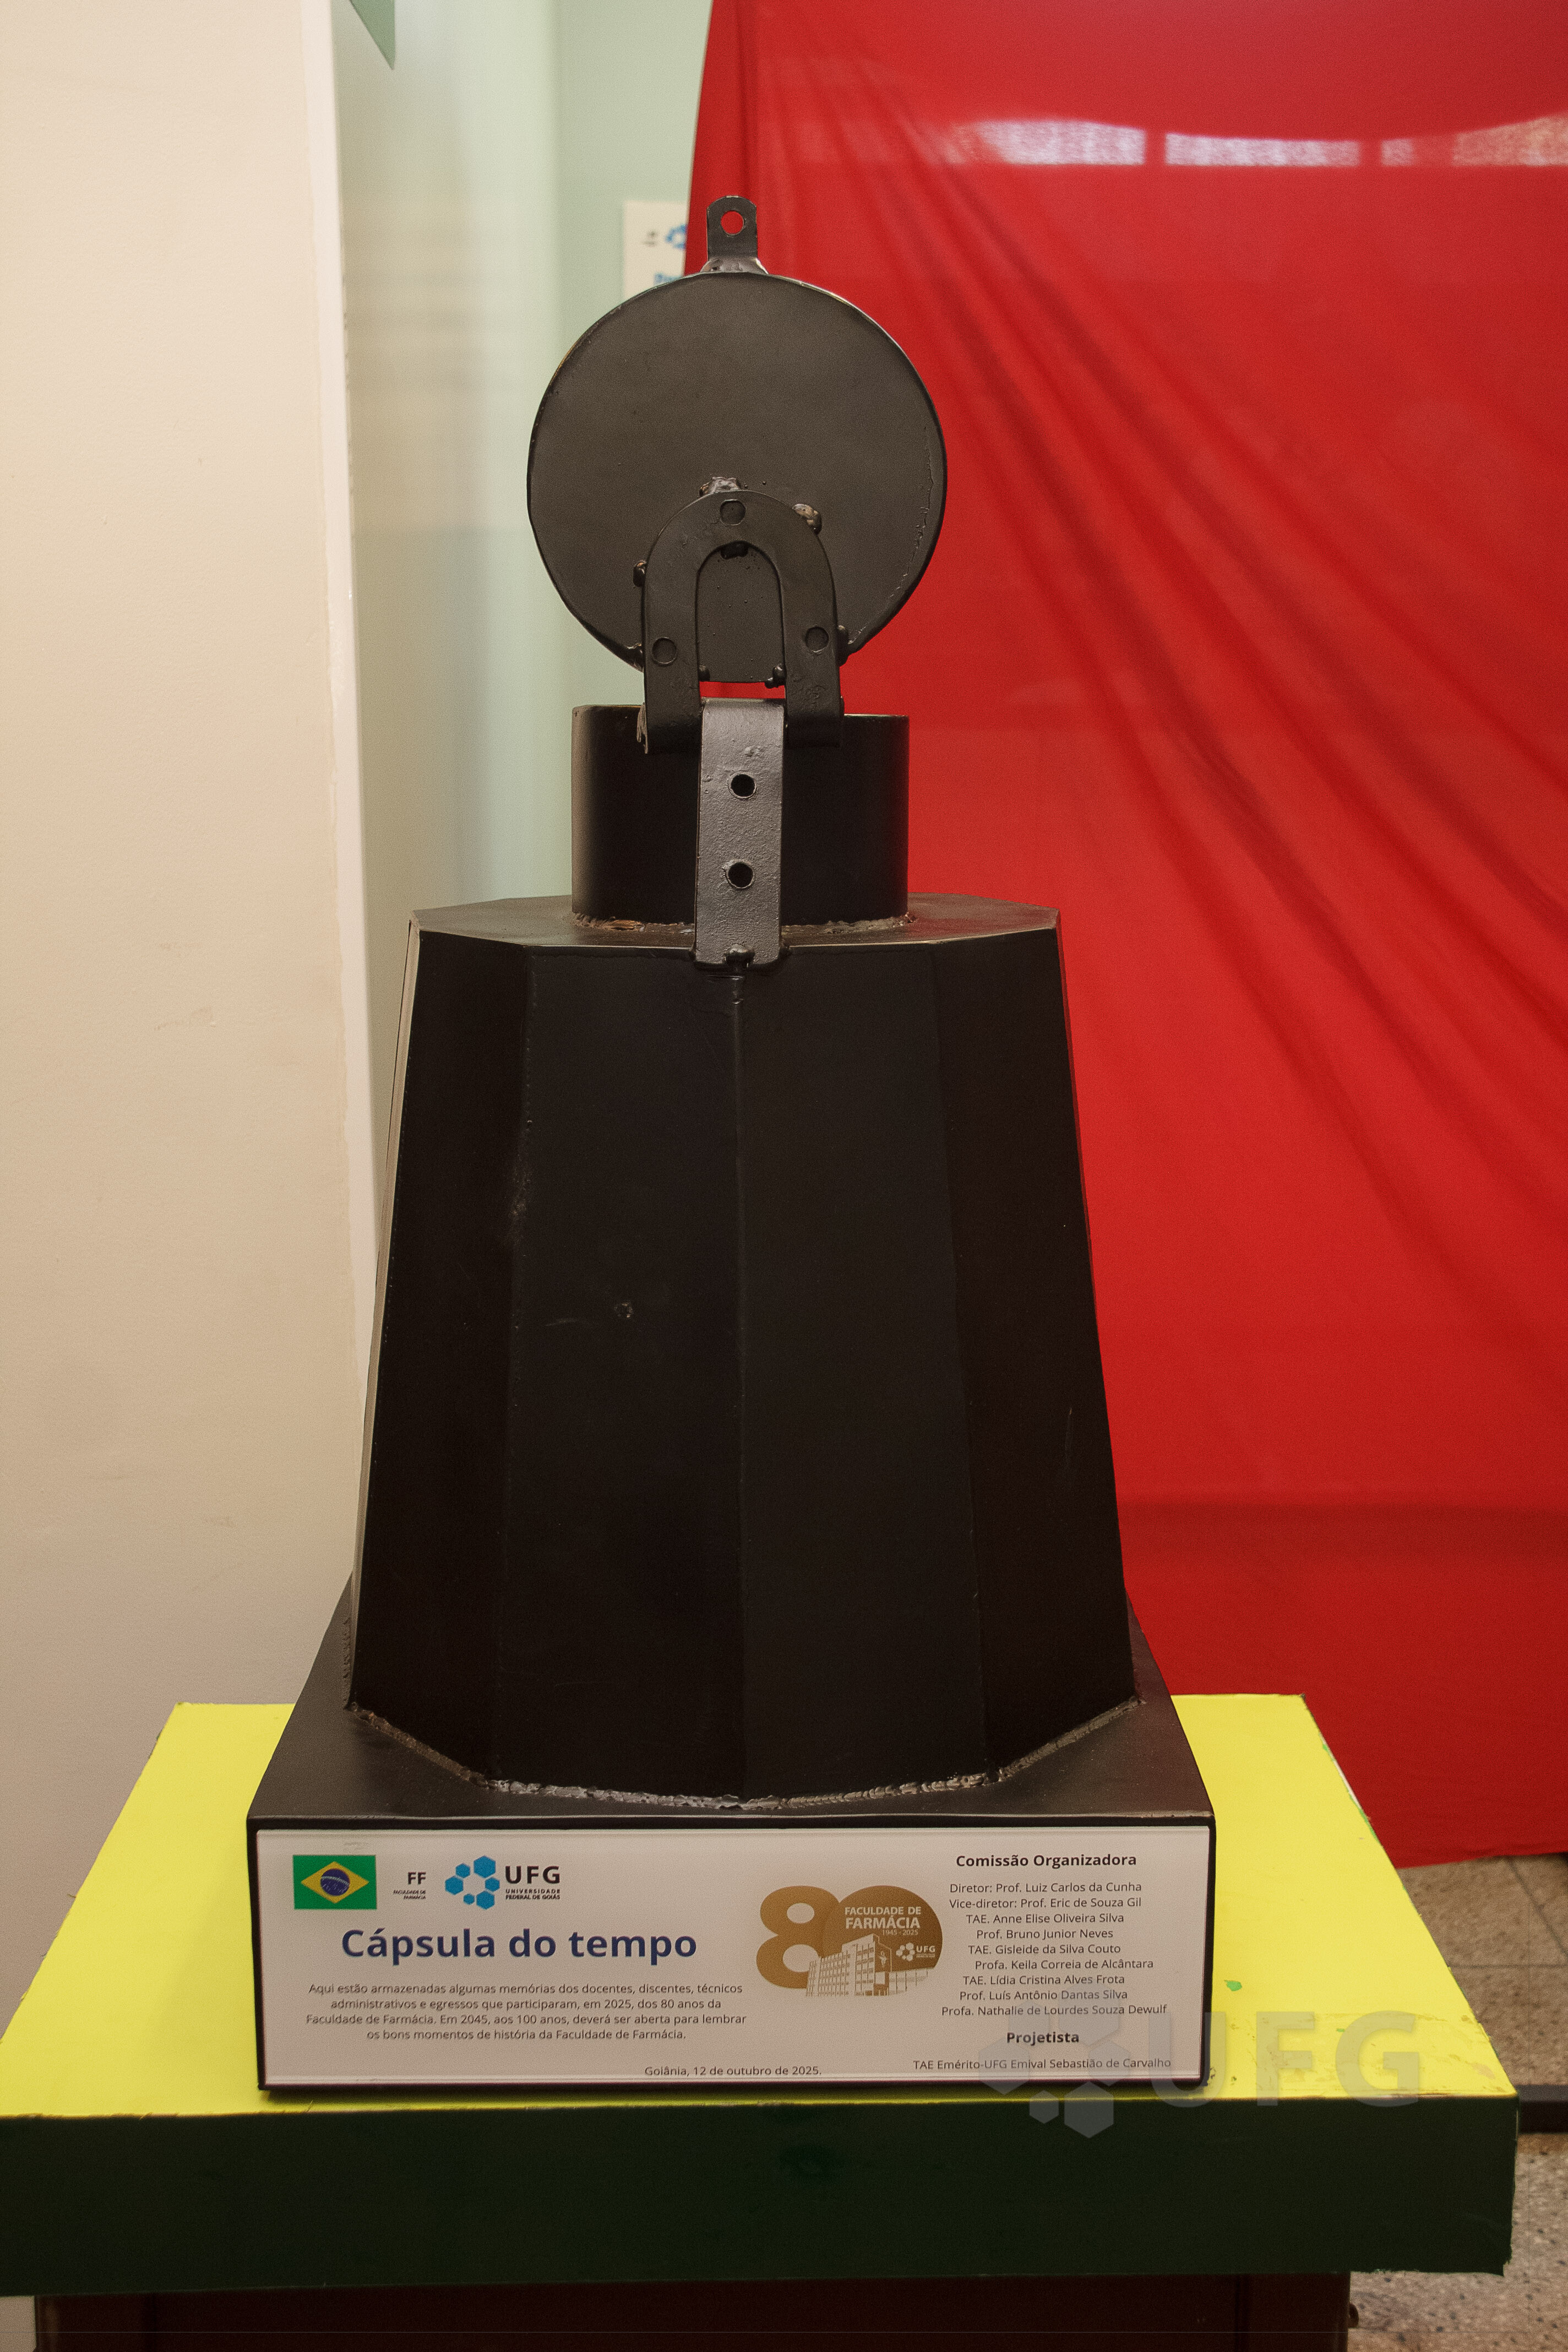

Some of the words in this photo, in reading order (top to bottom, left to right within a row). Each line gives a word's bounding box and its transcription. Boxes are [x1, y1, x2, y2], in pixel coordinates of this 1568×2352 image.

[956, 1854, 1029, 1867] Comissão
[1033, 1853, 1136, 1870] Organizadora
[407, 1871, 426, 1885] FF
[505, 1865, 560, 1885] UFG
[950, 1883, 993, 1893] Diretor:
[995, 1882, 1022, 1893] Prof.
[1025, 1883, 1048, 1893] Luiz
[1050, 1882, 1086, 1893] Carlos
[1088, 1882, 1103, 1892] da
[1106, 1882, 1142, 1892] Cunha
[949, 1898, 1017, 1909] Vice-diretor:
[1020, 1897, 1047, 1908] Prof.
[1050, 1898, 1070, 1908] Eric
[1073, 1897, 1088, 1908] de
[1090, 1897, 1124, 1908] Souza
[1126, 1897, 1142, 1907] Gil
[844, 1906, 904, 1915] FACULDADE
[907, 1906, 922, 1915] DE
[846, 1915, 921, 1930] FARMÁCIA
[966, 1914, 990, 1924] TAE.
[993, 1914, 1022, 1924] Anne
[1025, 1914, 1050, 1924] Elise
[1053, 1913, 1096, 1924] Oliveira
[1099, 1913, 1124, 1923] Silva
[976, 1929, 1003, 1940] Prof.
[1006, 1929, 1041, 1939] Bruno
[1042, 1929, 1076, 1941] Junior
[1079, 1929, 1114, 1939] Neves
[342, 1928, 495, 1966] Cápsula
[509, 1928, 556, 1958] do
[568, 1931, 697, 1966] tempo
[916, 1945, 935, 1953] UFG
[968, 1945, 992, 1955] TAE.
[995, 1944, 1039, 1954] Gisleide
[1042, 1944, 1057, 1954] da
[1059, 1944, 1085, 1954] Silva
[1087, 1943, 1121, 1954] Couto
[975, 1959, 1008, 1970] Profa.
[1011, 1959, 1038, 1970] Keila
[1041, 1959, 1081, 1970] Correia
[1084, 1959, 1099, 1969] de
[1101, 1958, 1154, 1969] Alcântara
[962, 1975, 987, 1986] TAE.
[990, 1975, 1016, 1985] Lídia
[1019, 1975, 1061, 1985] Cristina
[1064, 1974, 1093, 1985] Alves
[1096, 1974, 1125, 1984] Frota
[308, 1984, 334, 1996] Aqui
[337, 1984, 368, 1994] estão
[371, 1984, 447, 1994] armazenadas
[449, 1984, 497, 1996] algumas
[499, 1983, 556, 1994] memórias
[558, 1984, 579, 1994] dos
[581, 1984, 635, 1995] docentes,
[638, 1984, 694, 1995] discentes,
[697, 1983, 743, 1994] técnicos
[960, 1990, 986, 2001] Prof.
[989, 1990, 1011, 2001] Luís
[1014, 1990, 1058, 2001] Antônio
[1061, 1990, 1100, 2000] Dantas
[1103, 1989, 1128, 2000] Silva
[330, 1999, 417, 2010] administrativos
[419, 2001, 427, 2010] e
[429, 2001, 479, 2012] egressos
[481, 2001, 503, 2011] que
[506, 1999, 580, 2012] participaram,
[583, 2001, 601, 2010] em
[604, 1999, 634, 2010] 2025,
[637, 1999, 658, 2009] dos
[660, 1999, 675, 2009] 80
[677, 2001, 705, 2009] anos
[707, 1999, 721, 2009] da
[941, 2006, 974, 2016] Profa.
[977, 2005, 1024, 2016] Nathalie
[1026, 2006, 1041, 2016] de
[1044, 2005, 1089, 2016] Lourdes
[1092, 2005, 1125, 2015] Souza
[1128, 2003, 1167, 2015] Dewulf
[306, 2014, 363, 2024] Faculdade
[365, 2014, 380, 2024] de
[383, 2014, 437, 2024] Farmácia.
[440, 2015, 458, 2024] Em
[460, 2014, 491, 2026] 2045,
[493, 2016, 514, 2024] aos
[517, 2015, 537, 2024] 100
[540, 2016, 570, 2026] anos,
[572, 2014, 611, 2024] deverá
[613, 2016, 631, 2024] ser
[634, 2014, 671, 2024] aberta
[673, 2016, 699, 2027] para
[702, 2014, 747, 2024] lembrar
[366, 2031, 380, 2040] os
[383, 2029, 411, 2040] bons
[413, 2030, 474, 2040] momentos
[476, 2029, 491, 2040] de
[494, 2029, 536, 2040] história
[538, 2029, 553, 2040] da
[556, 2029, 613, 2040] Faculdade
[615, 2029, 630, 2040] de
[633, 2029, 686, 2040] Farmácia.
[1006, 2031, 1080, 2047] Projetista
[913, 2060, 934, 2070] TAE
[937, 2059, 1008, 2070] Emérito-UFG
[1010, 2059, 1047, 2069] Emival
[1049, 2059, 1103, 2069] Sebastião
[1106, 2059, 1120, 2068] de
[1123, 2058, 1172, 2068] Carvalho
[644, 2066, 689, 2076] Goiânia,
[694, 2066, 706, 2076] 12
[709, 2066, 724, 2076] de
[726, 2066, 772, 2076] outubro
[774, 2065, 789, 2076] de
[792, 2066, 822, 2076] 2025.
